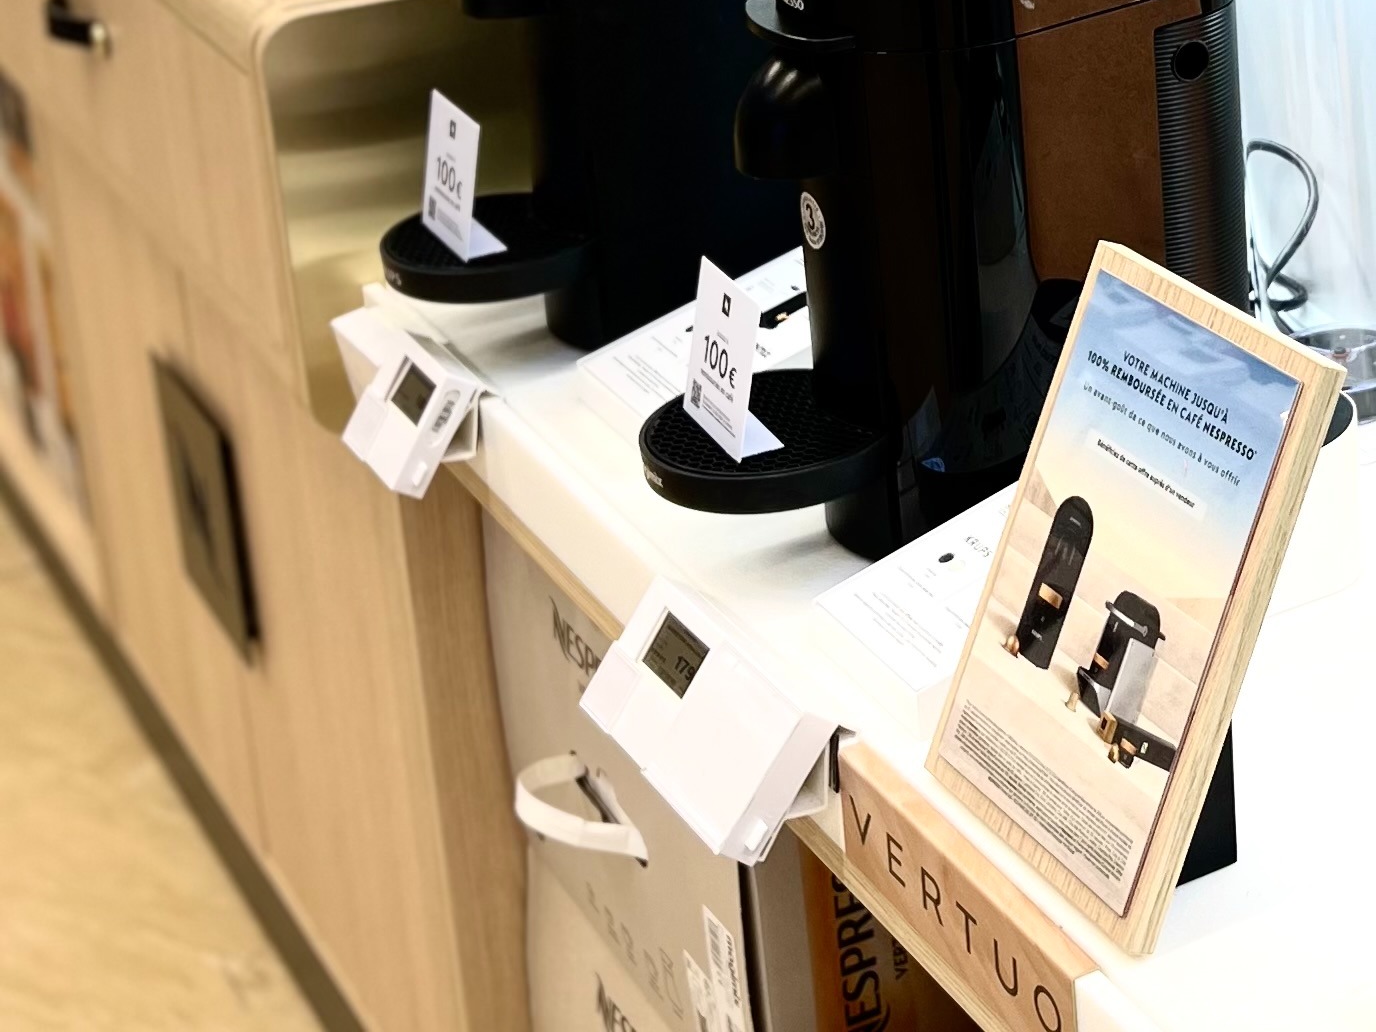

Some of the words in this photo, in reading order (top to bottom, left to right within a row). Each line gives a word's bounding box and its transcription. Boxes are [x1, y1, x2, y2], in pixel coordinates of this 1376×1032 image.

[805, 202, 815, 231] 3
[1087, 350, 1110, 373] 100%
[1110, 364, 1166, 407] REMBOURSÉE
[1166, 398, 1180, 415] EN
[1179, 407, 1204, 430] CAFÉ
[1123, 350, 1150, 376] VOTRE
[1149, 369, 1191, 401] MACHINE
[1190, 392, 1229, 425] JUSQU'À
[1128, 409, 1137, 421] de
[1137, 417, 1146, 427] ce
[1146, 423, 1160, 436] que
[1160, 431, 1177, 447] nous
[1176, 441, 1197, 459] avons
[1203, 458, 1220, 474] vous
[1219, 469, 1241, 487] offrir
[963, 535, 993, 558] KRUPS
[847, 794, 1062, 1032] VERTUO
